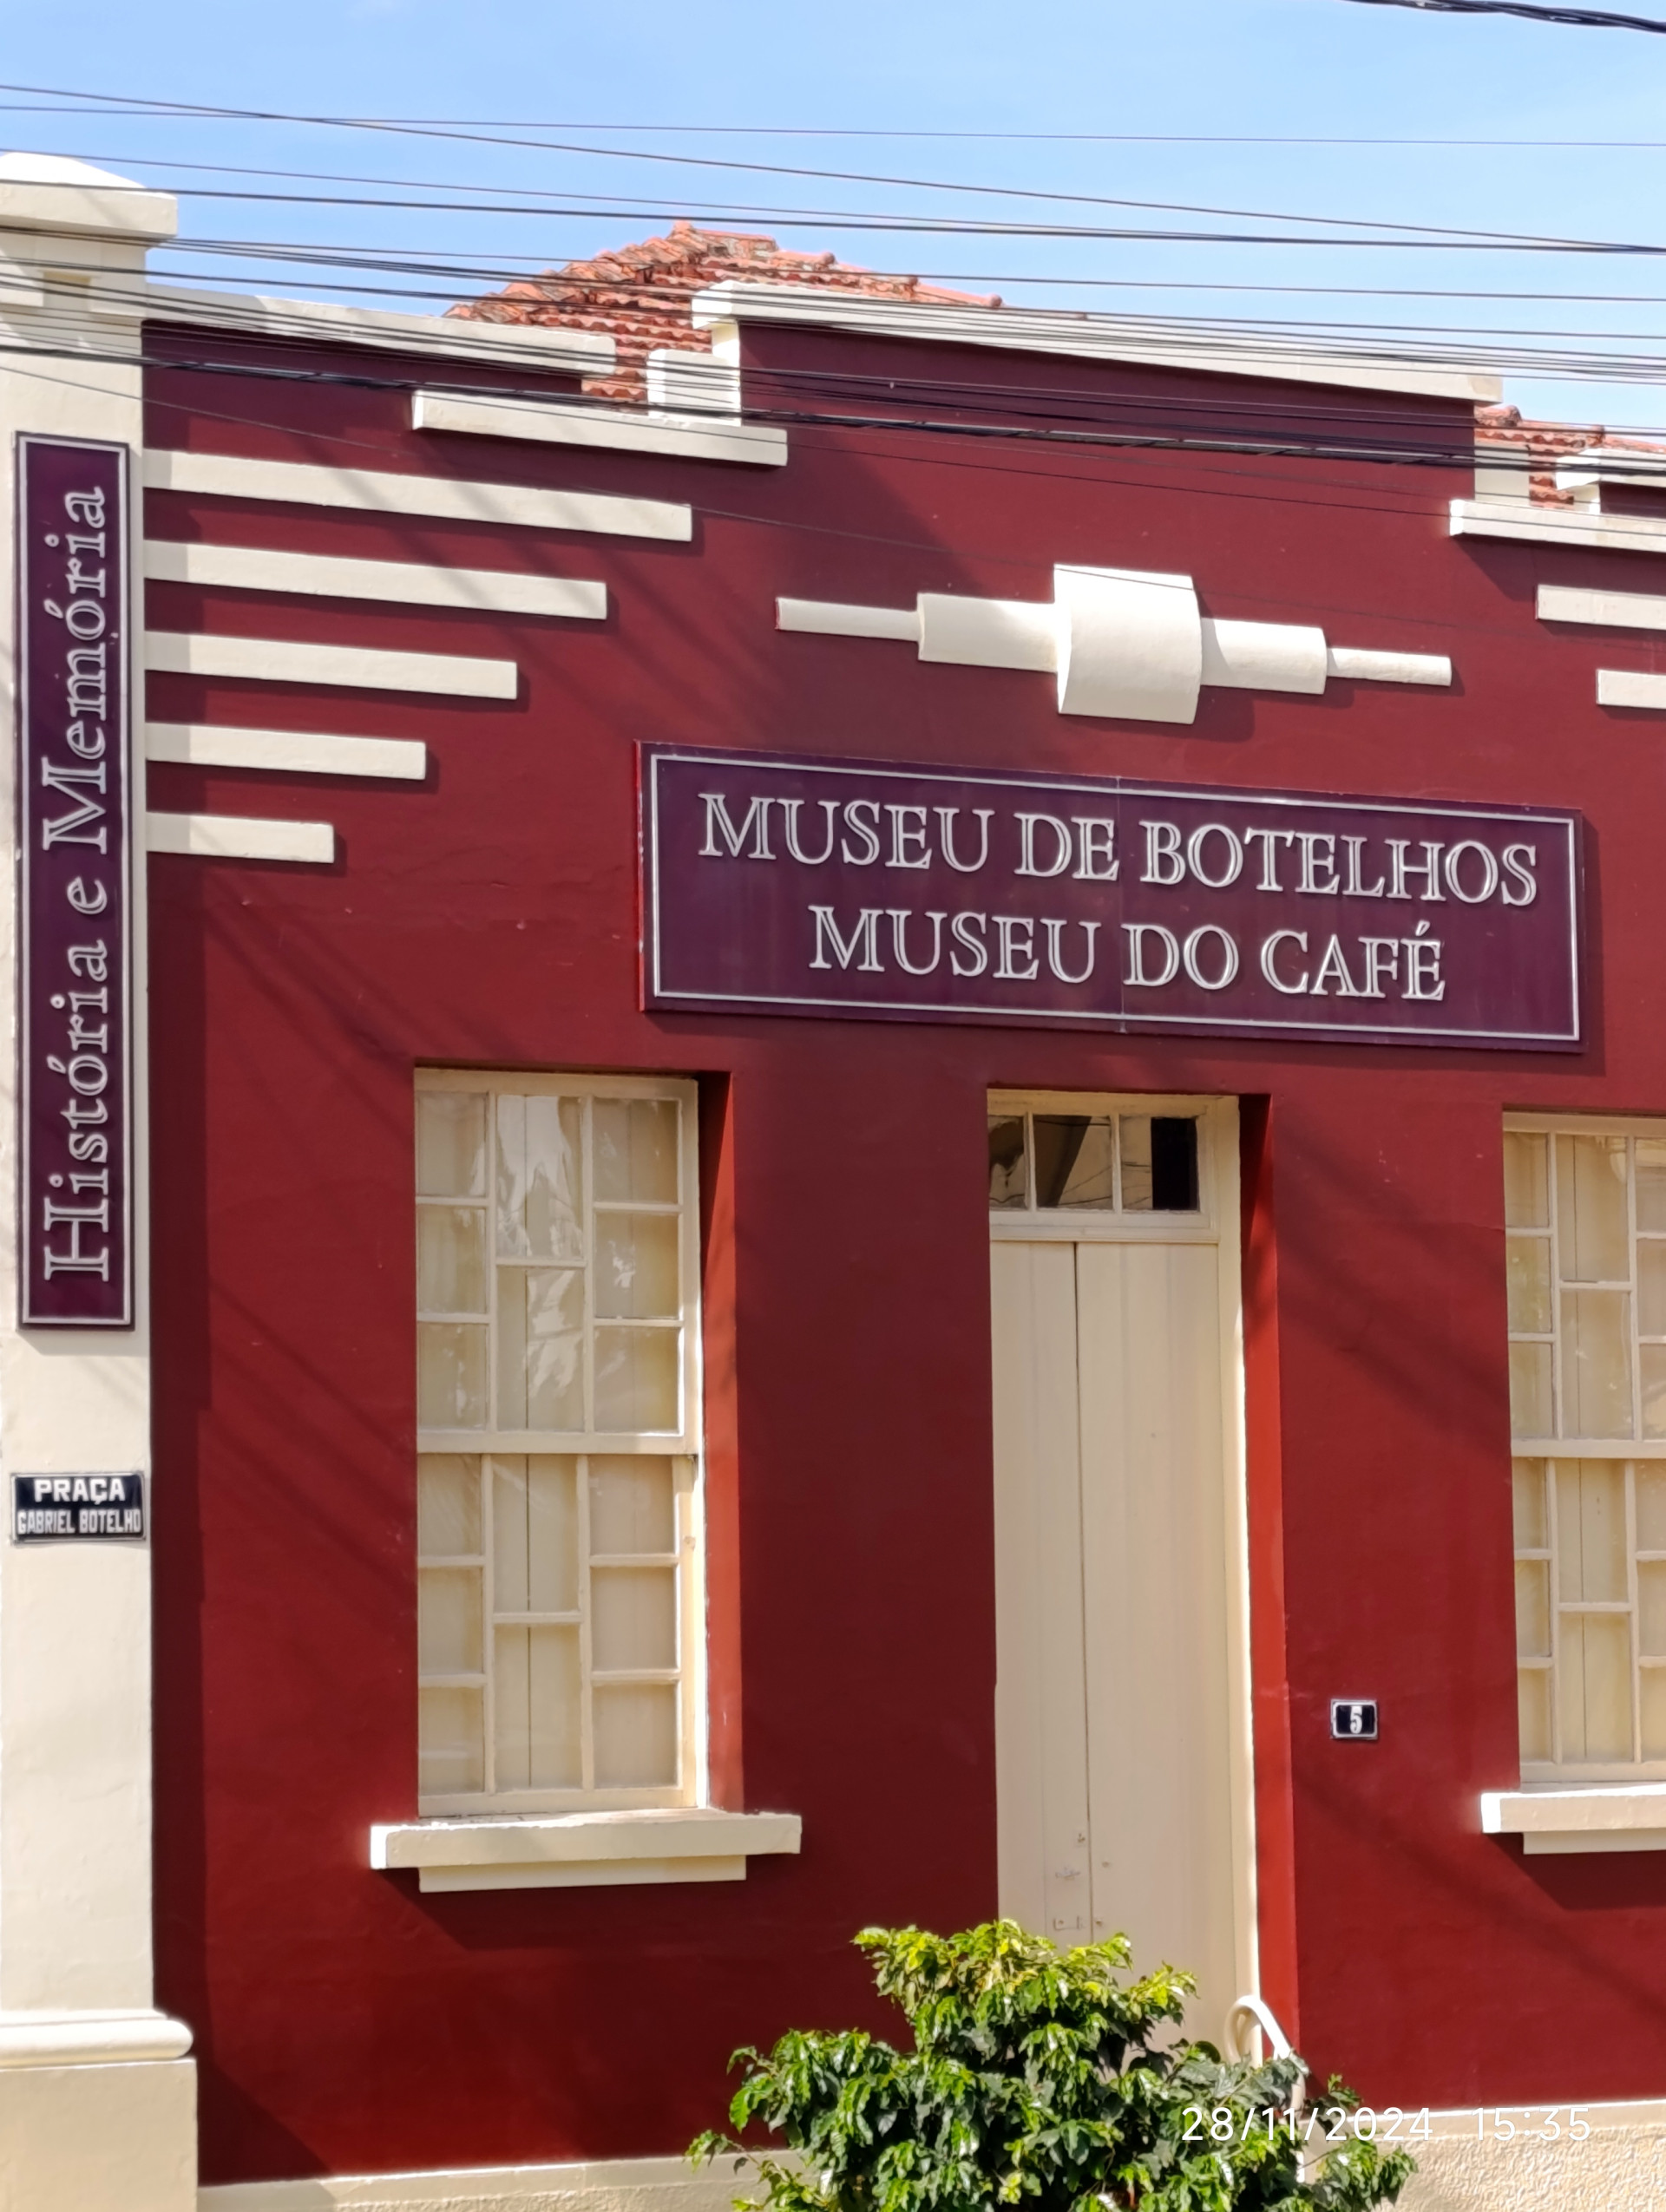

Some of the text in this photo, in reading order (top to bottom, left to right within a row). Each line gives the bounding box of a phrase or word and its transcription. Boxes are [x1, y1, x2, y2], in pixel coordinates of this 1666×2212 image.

[699, 793, 1538, 906] MUSEU DE BOTELHOS
[43, 486, 109, 1282] História e Memória
[809, 905, 1446, 1002] MUSEU DO CAFÉ
[17, 1508, 141, 1535] GABRIEL BOTELHO
[34, 1477, 126, 1505] PRAÇA
[1350, 1705, 1362, 1734] 5
